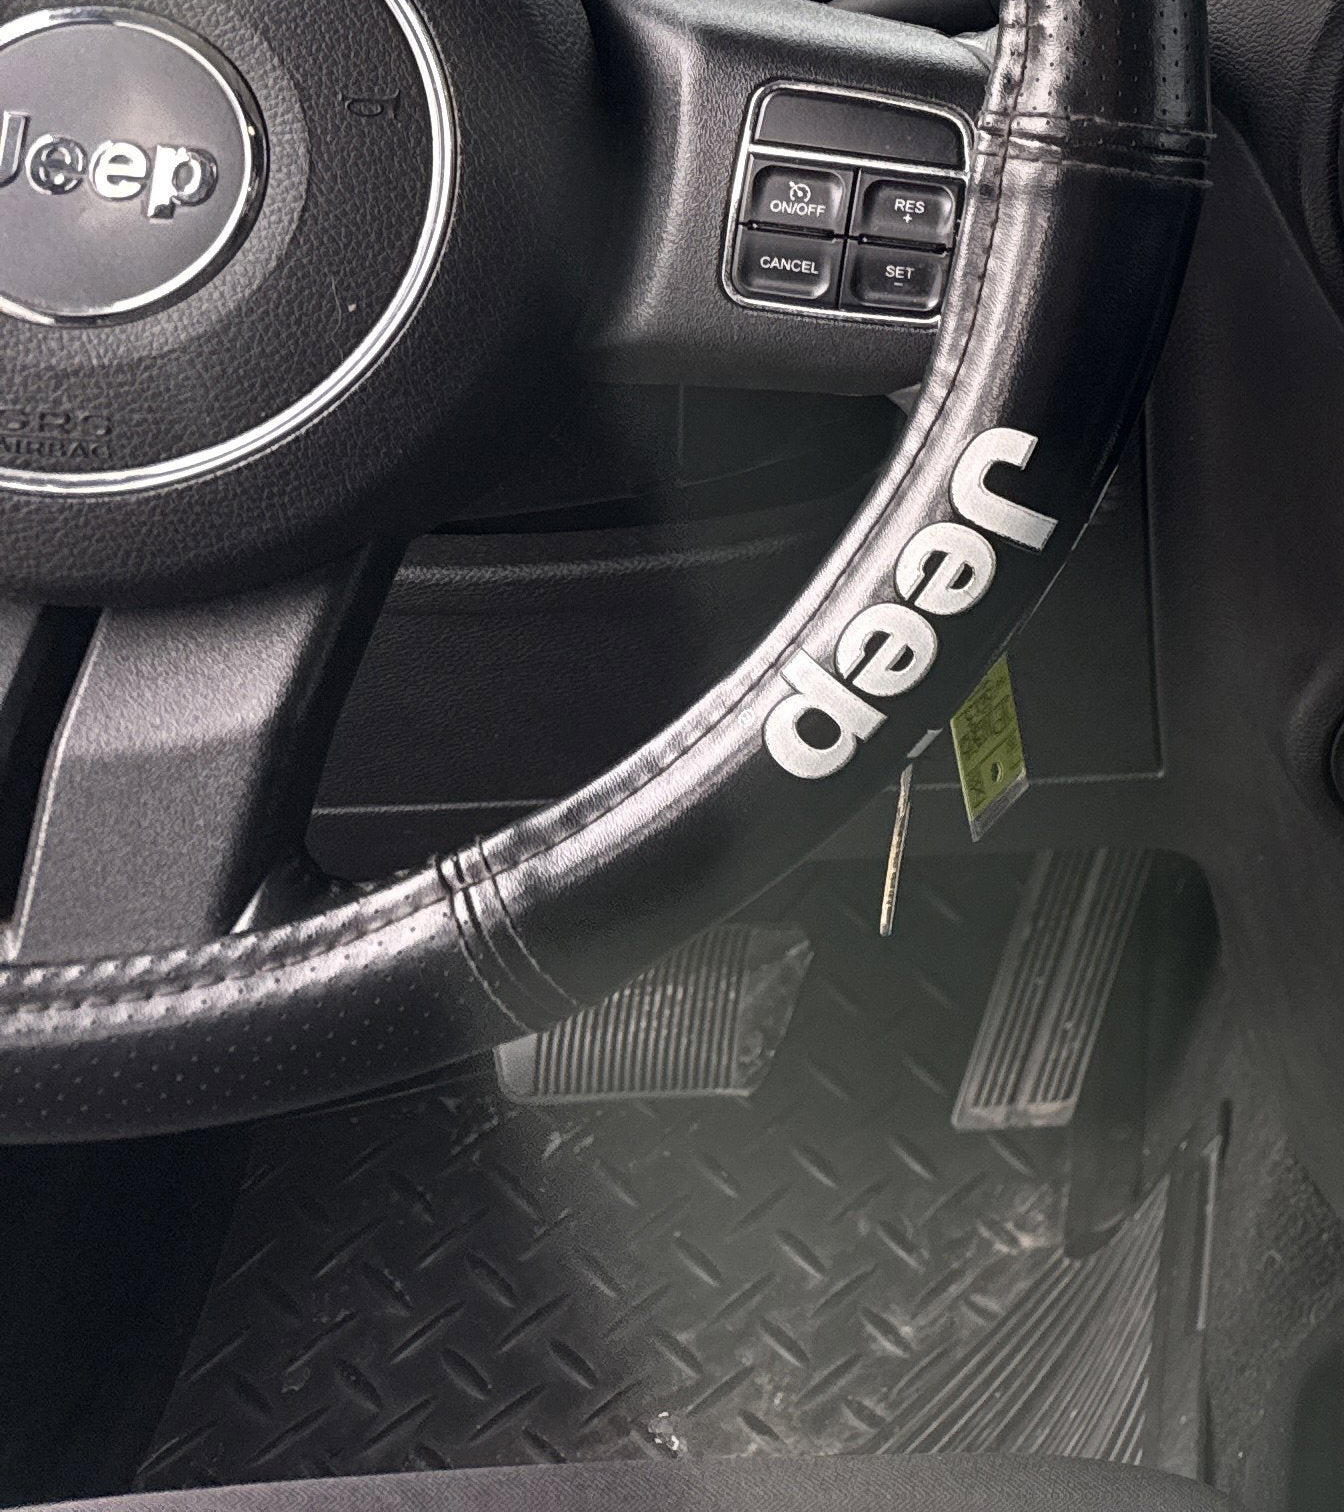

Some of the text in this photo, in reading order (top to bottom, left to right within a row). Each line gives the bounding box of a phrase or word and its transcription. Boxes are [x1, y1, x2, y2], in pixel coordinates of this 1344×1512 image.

[0, 110, 219, 224] Jeep
[770, 199, 826, 218] ON/OFF
[895, 199, 925, 213] RES
[760, 256, 819, 275] CANCEL
[885, 265, 915, 280] SET
[762, 426, 1059, 780] Jeep
